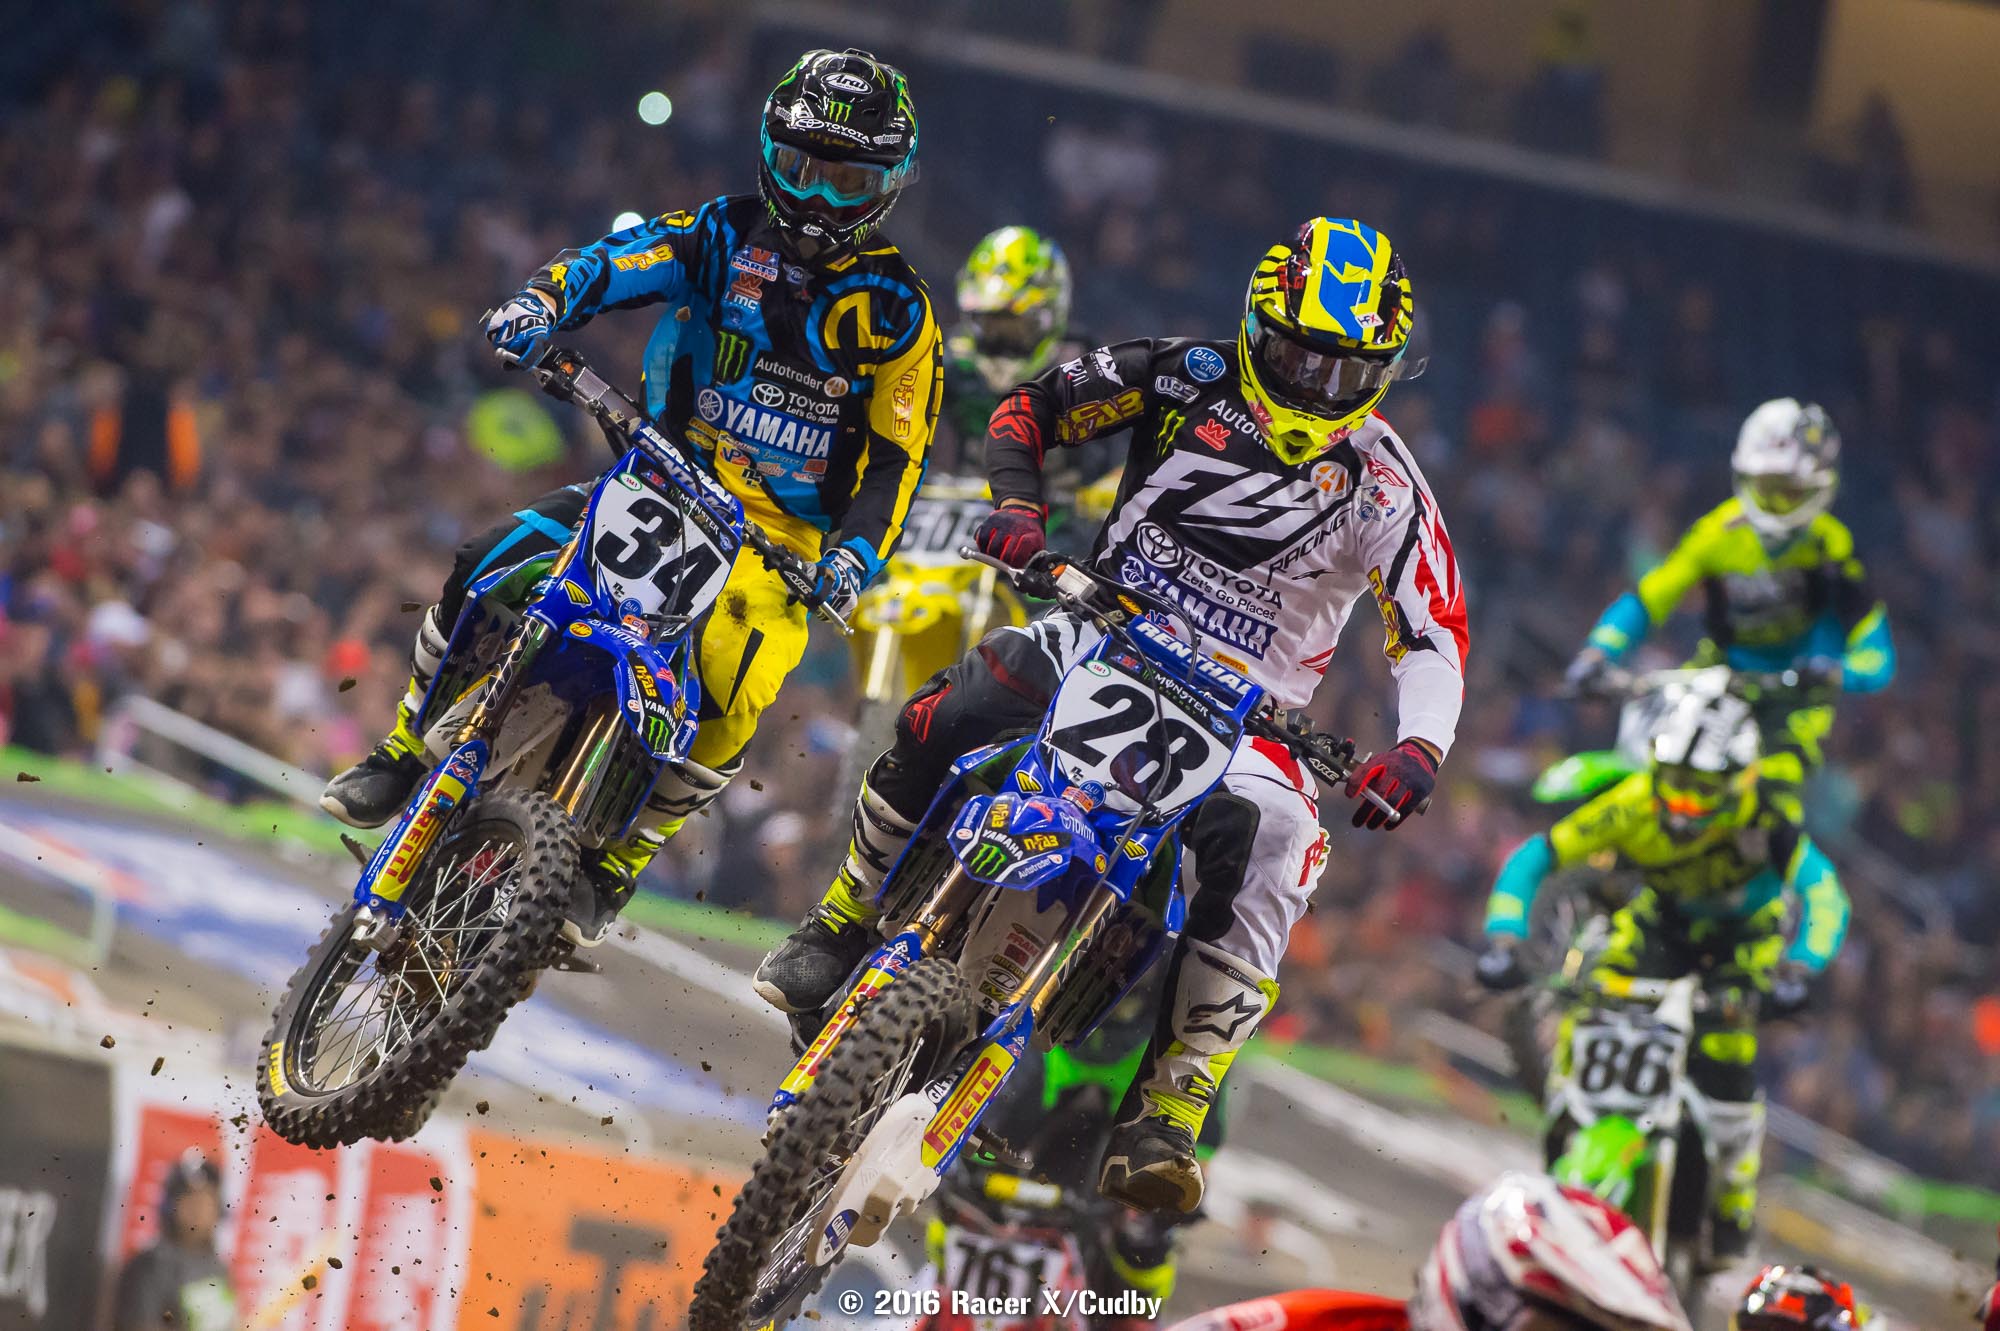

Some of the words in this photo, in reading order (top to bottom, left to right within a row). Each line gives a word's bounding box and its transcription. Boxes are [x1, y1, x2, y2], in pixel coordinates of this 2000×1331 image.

[834, 73, 867, 89] Arai
[824, 121, 870, 144] TOYOTA
[755, 358, 824, 390] Autotrader
[725, 399, 831, 458] YAMAHA
[785, 405, 804, 417] Let's
[806, 412, 817, 422] Go
[788, 392, 840, 416] TOYOTA
[594, 497, 722, 622] 34
[1267, 503, 1354, 586] RACING
[1182, 571, 1213, 595] Let's
[1216, 589, 1236, 607] Go
[1237, 597, 1277, 621] Places
[1184, 547, 1283, 610] TOYOTA
[1149, 571, 1271, 656] YAMAHA
[644, 699, 677, 732] YAMAHA
[1050, 683, 1210, 805] 28
[982, 829, 1024, 861] YAMAHA
[1580, 1037, 1675, 1097] 86
[924, 1057, 1003, 1156] PIRELLI
